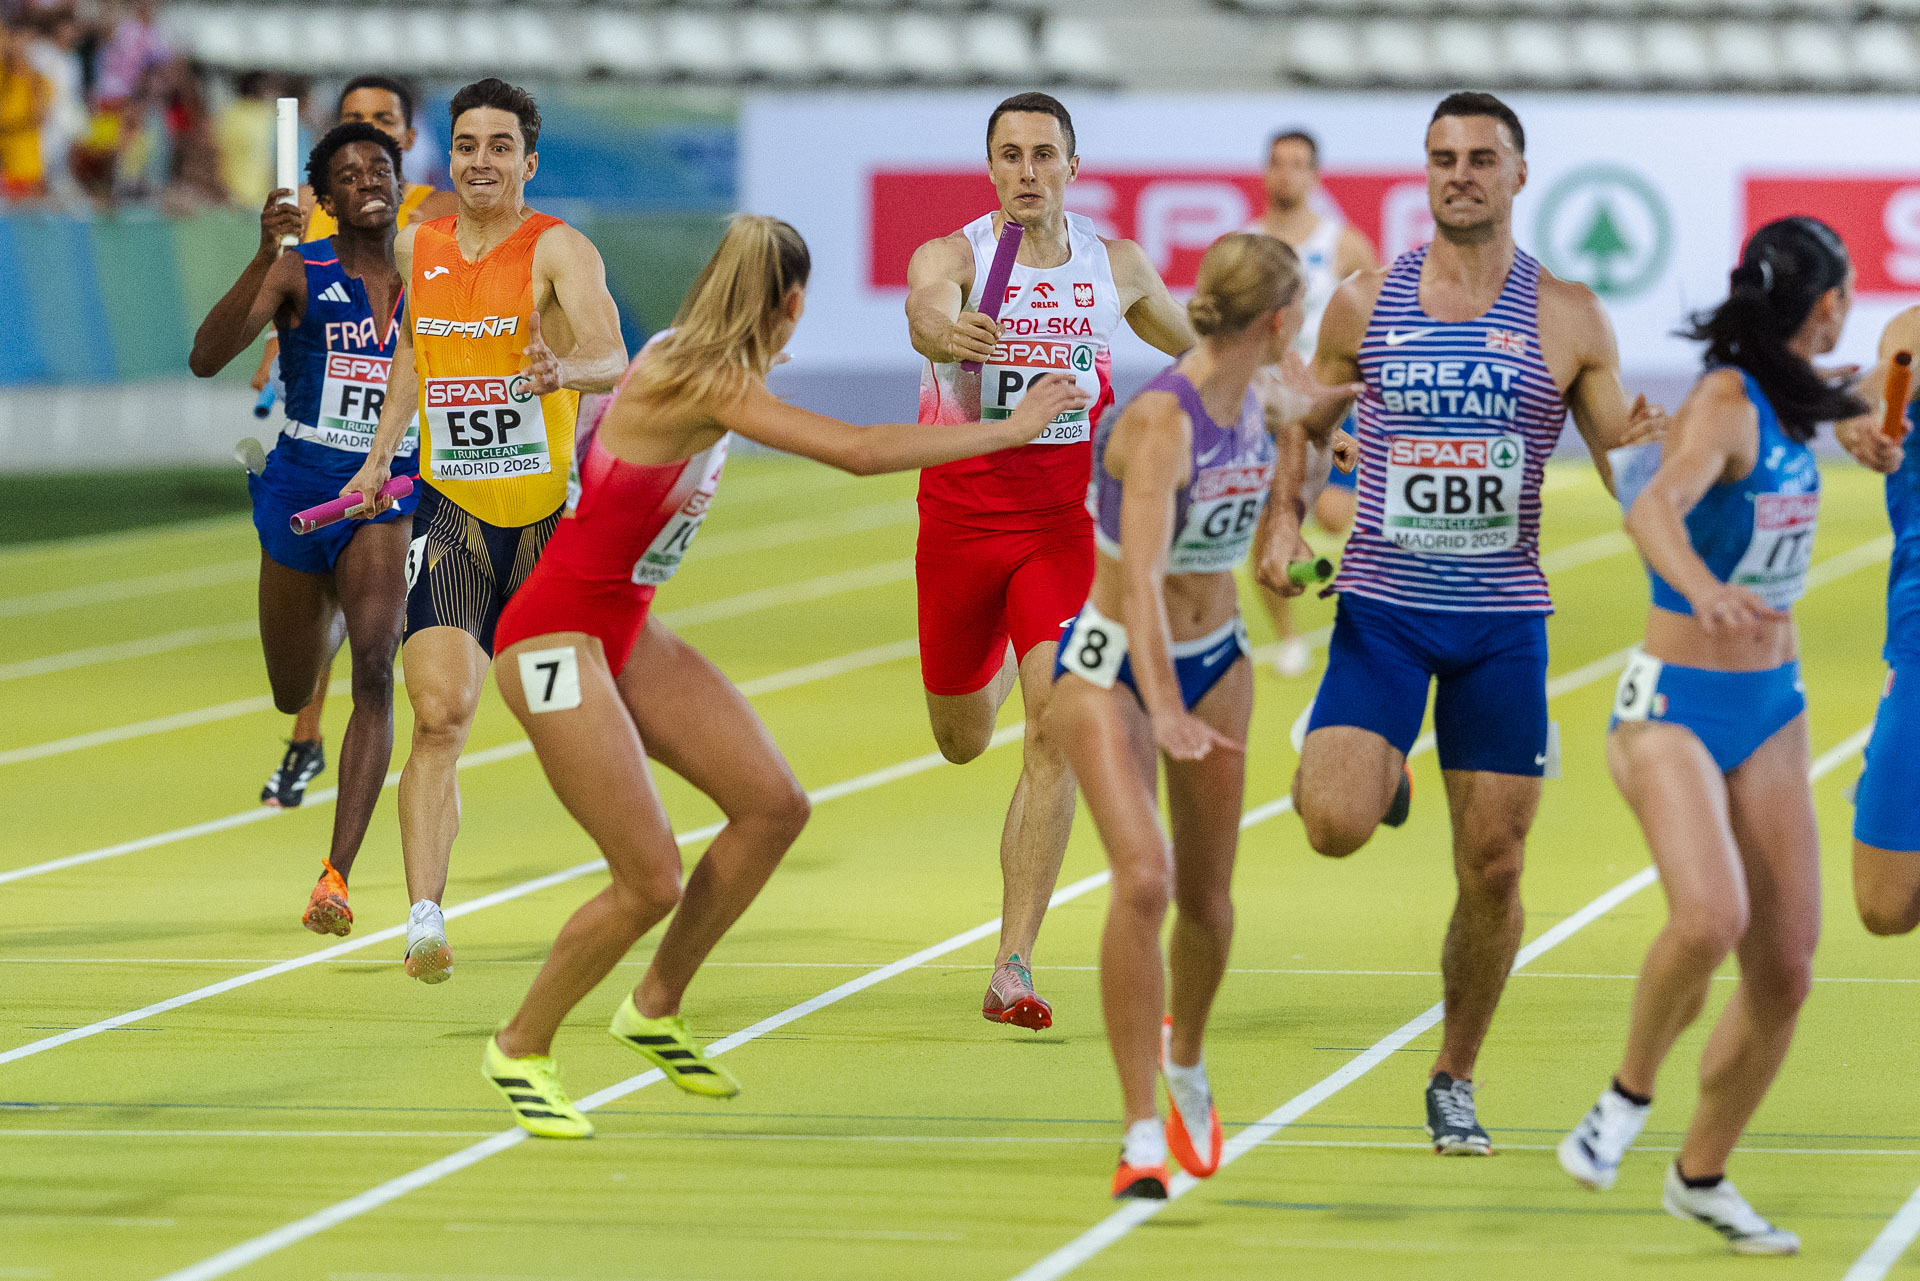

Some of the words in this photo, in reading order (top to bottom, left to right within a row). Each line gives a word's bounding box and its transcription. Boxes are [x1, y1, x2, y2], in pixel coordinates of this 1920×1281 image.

[1031, 301, 1059, 309] ORLEN
[415, 315, 519, 339] ESPAÑA
[1001, 317, 1093, 336] POLSKA
[988, 344, 1069, 366] SPAR
[330, 357, 391, 382] SPA
[1381, 361, 1520, 392] GREAT
[429, 382, 506, 404] SPAR
[1382, 389, 1518, 420] BRITAIN
[347, 423, 371, 433] RUN
[446, 408, 522, 447] ESP
[1055, 425, 1083, 439] 2025
[326, 431, 373, 448] MADRI
[453, 450, 457, 459] I
[458, 449, 480, 459] RUN
[1391, 440, 1485, 466] SPAR
[440, 461, 500, 477] MADRID
[503, 457, 540, 473] 2025
[1404, 473, 1505, 514] GBR
[1395, 531, 1466, 548] MADRID
[1471, 531, 1506, 549] 2025
[1080, 629, 1108, 669] 8
[535, 661, 560, 702] 7
[1622, 665, 1643, 707] 6
